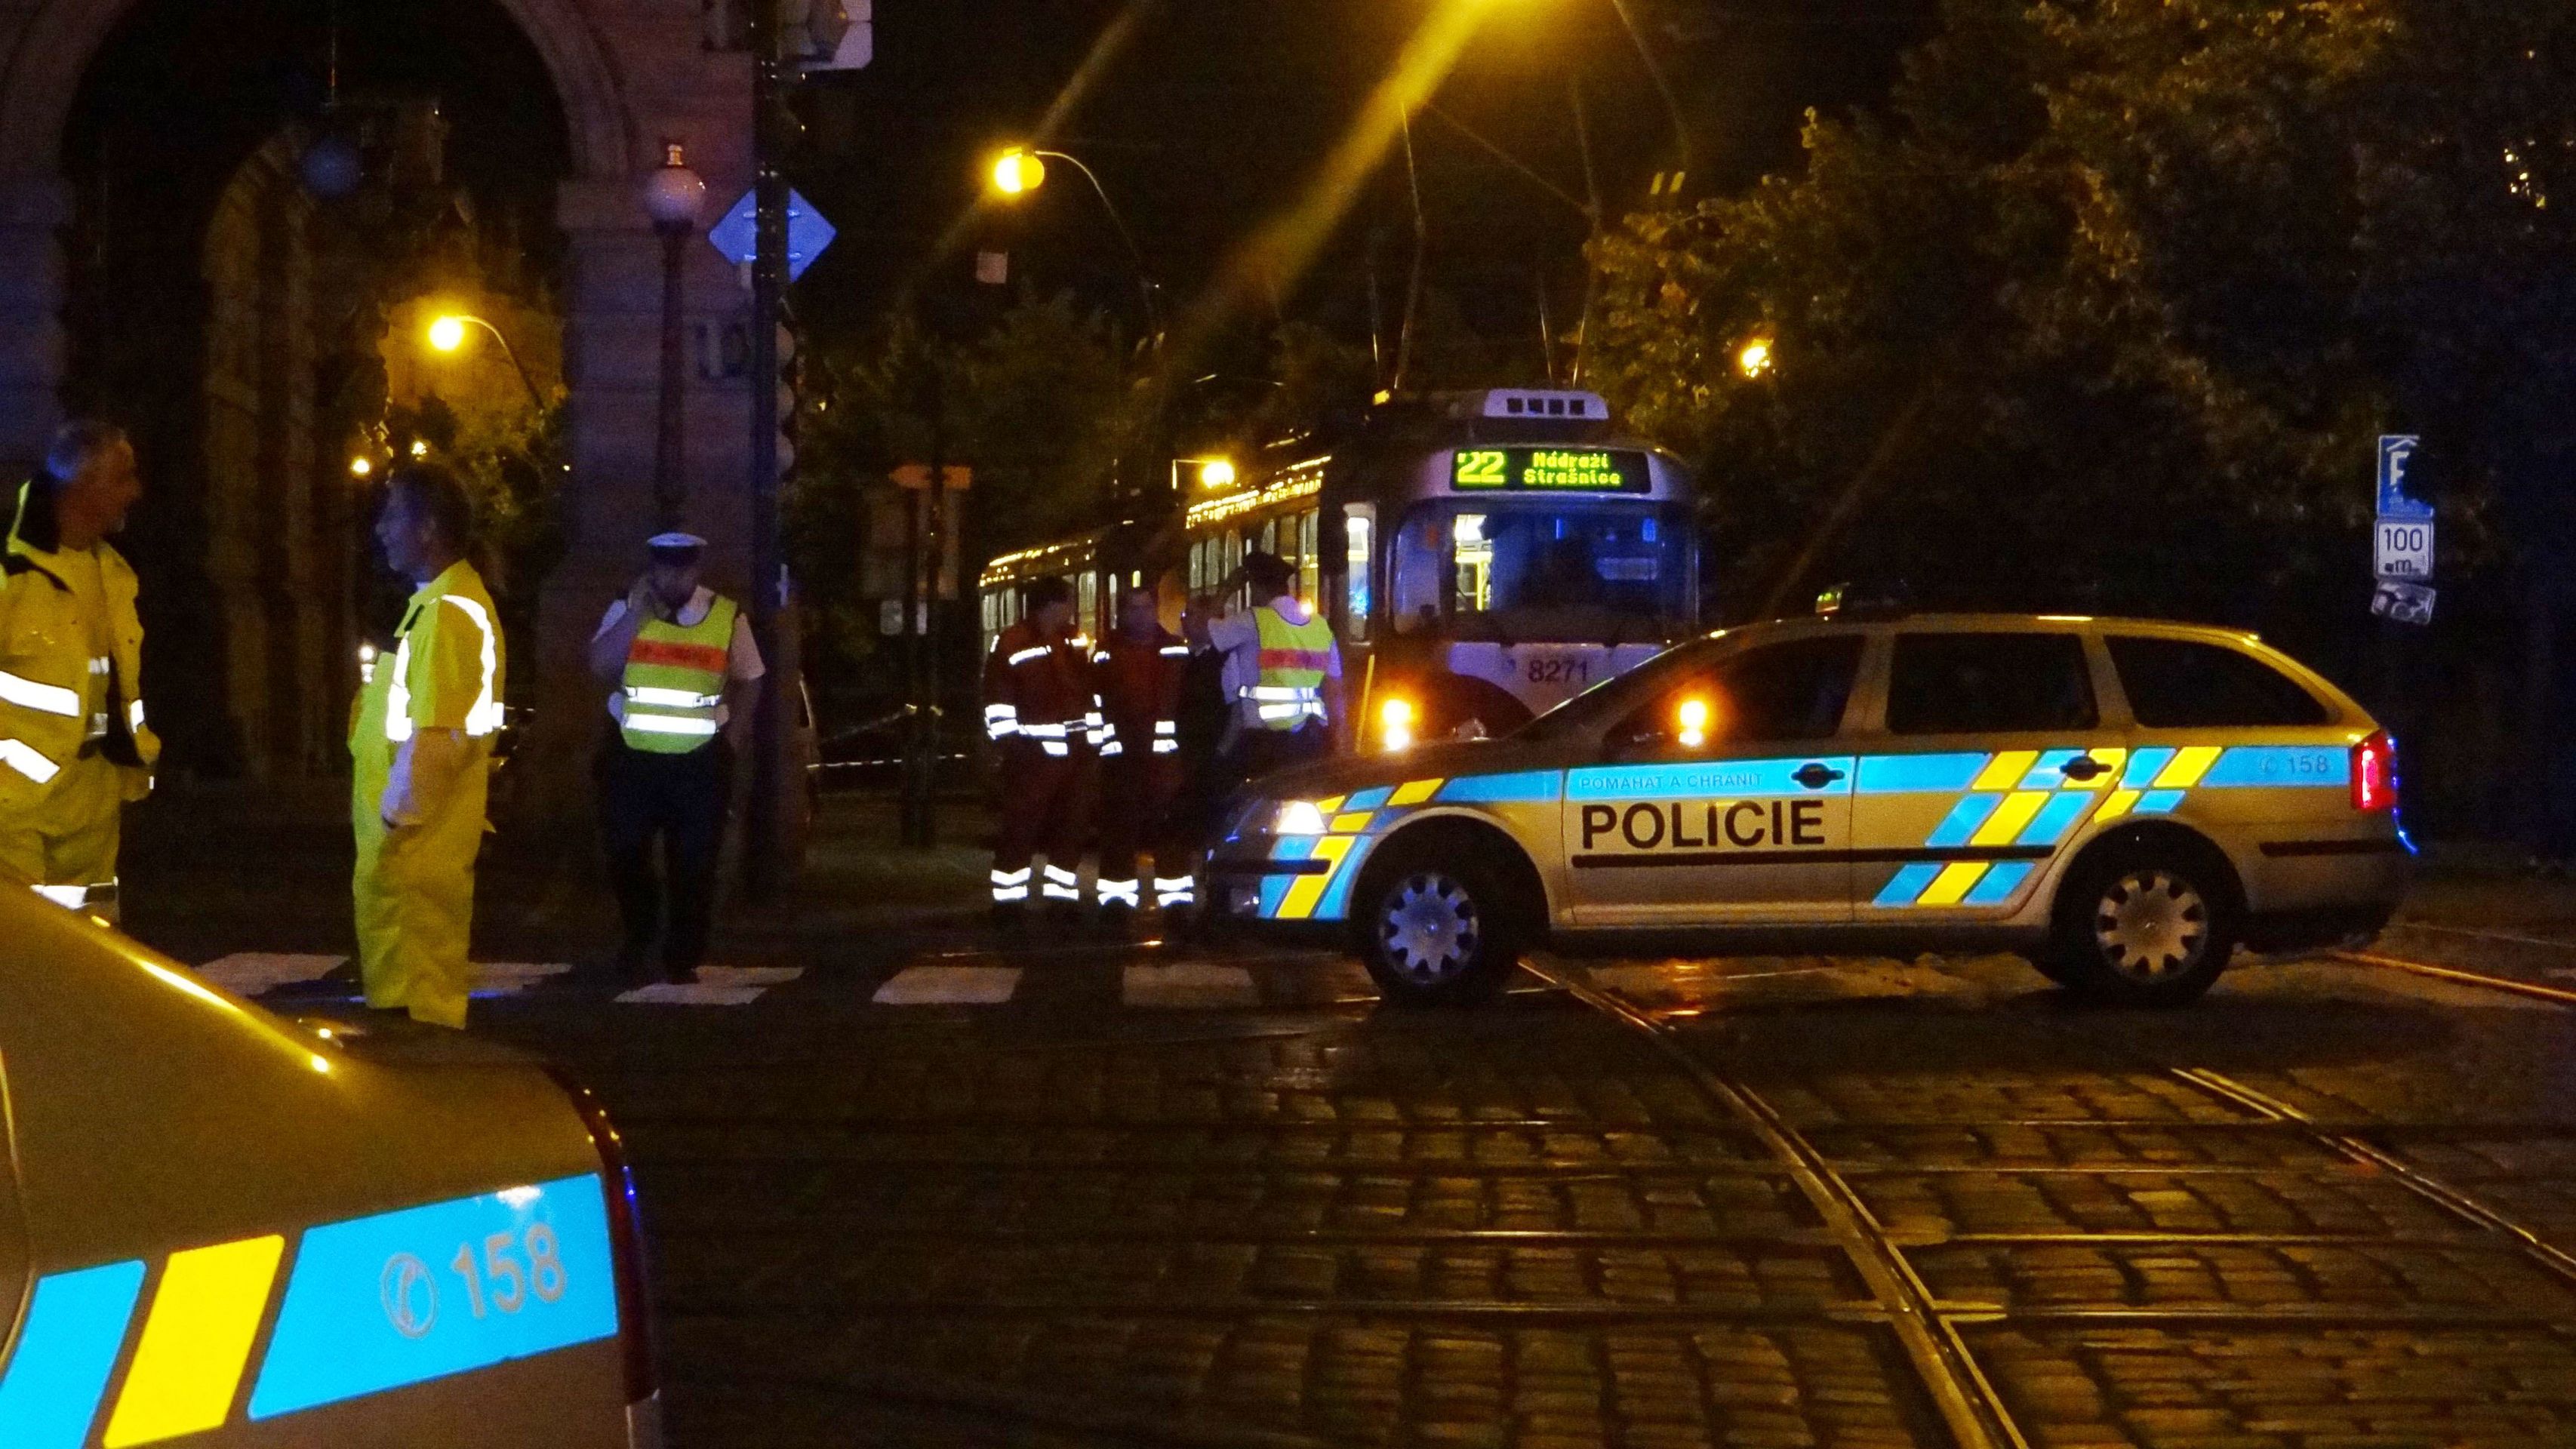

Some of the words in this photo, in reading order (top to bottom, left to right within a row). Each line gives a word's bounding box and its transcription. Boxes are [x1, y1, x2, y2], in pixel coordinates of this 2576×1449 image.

[1457, 451, 1505, 484] 22
[1524, 468, 1620, 485] Strašnice
[2384, 528, 2423, 552] 100
[1528, 656, 1588, 682] 8271
[2288, 755, 2328, 775] 158
[1670, 775, 1681, 788] A
[1581, 800, 1826, 849] POLICIE
[451, 1222, 568, 1320] 158
